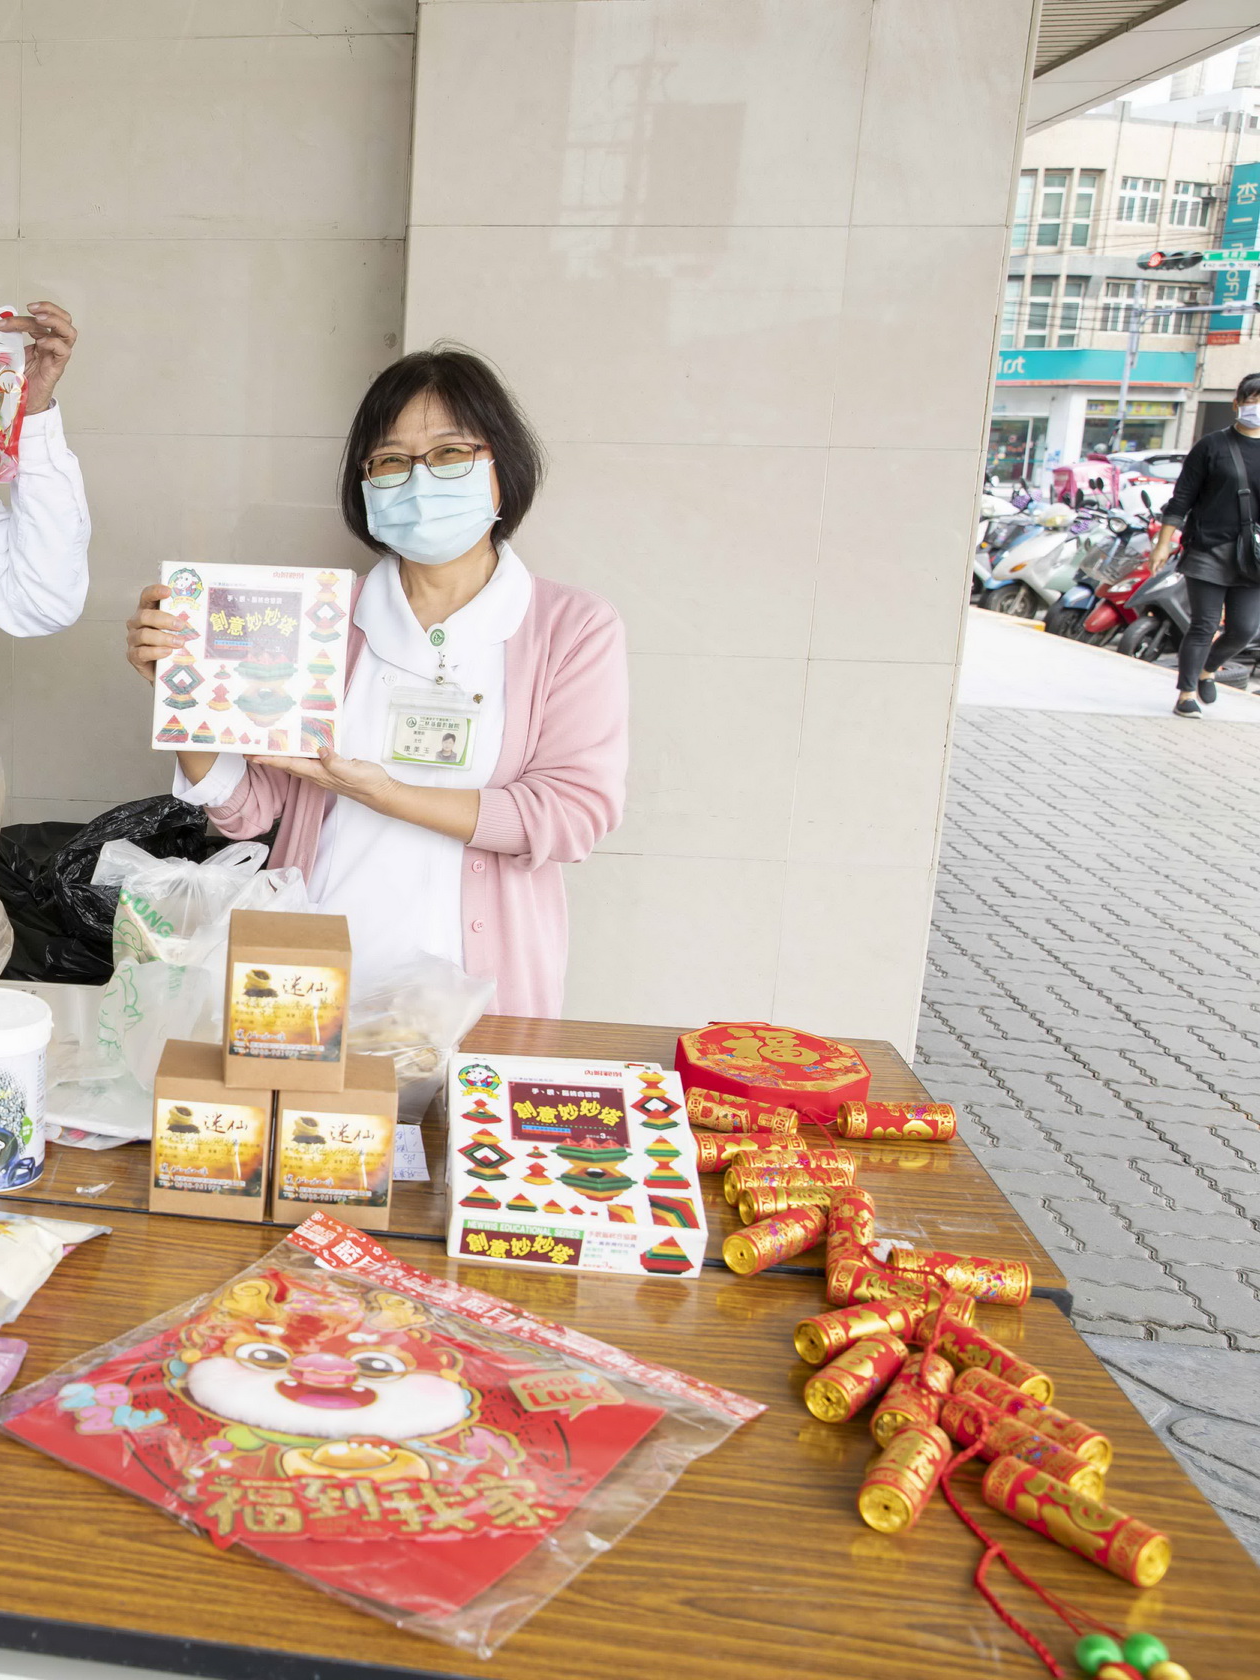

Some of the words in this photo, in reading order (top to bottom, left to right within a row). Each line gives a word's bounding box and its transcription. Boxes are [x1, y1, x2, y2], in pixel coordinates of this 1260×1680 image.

[209, 606, 298, 637] 創意妙妙塔
[721, 1027, 821, 1066] 福
[512, 1098, 624, 1127] 創意妙妙塔
[467, 1221, 498, 1231] NEWWIS
[500, 1223, 552, 1236] EDUCATIONAL
[554, 1228, 581, 1238] SERIES
[465, 1231, 576, 1265] 創意妙妙塔
[520, 1374, 578, 1391] GOOD
[527, 1384, 617, 1408] LUCK
[204, 1472, 558, 1537] 福到我家
